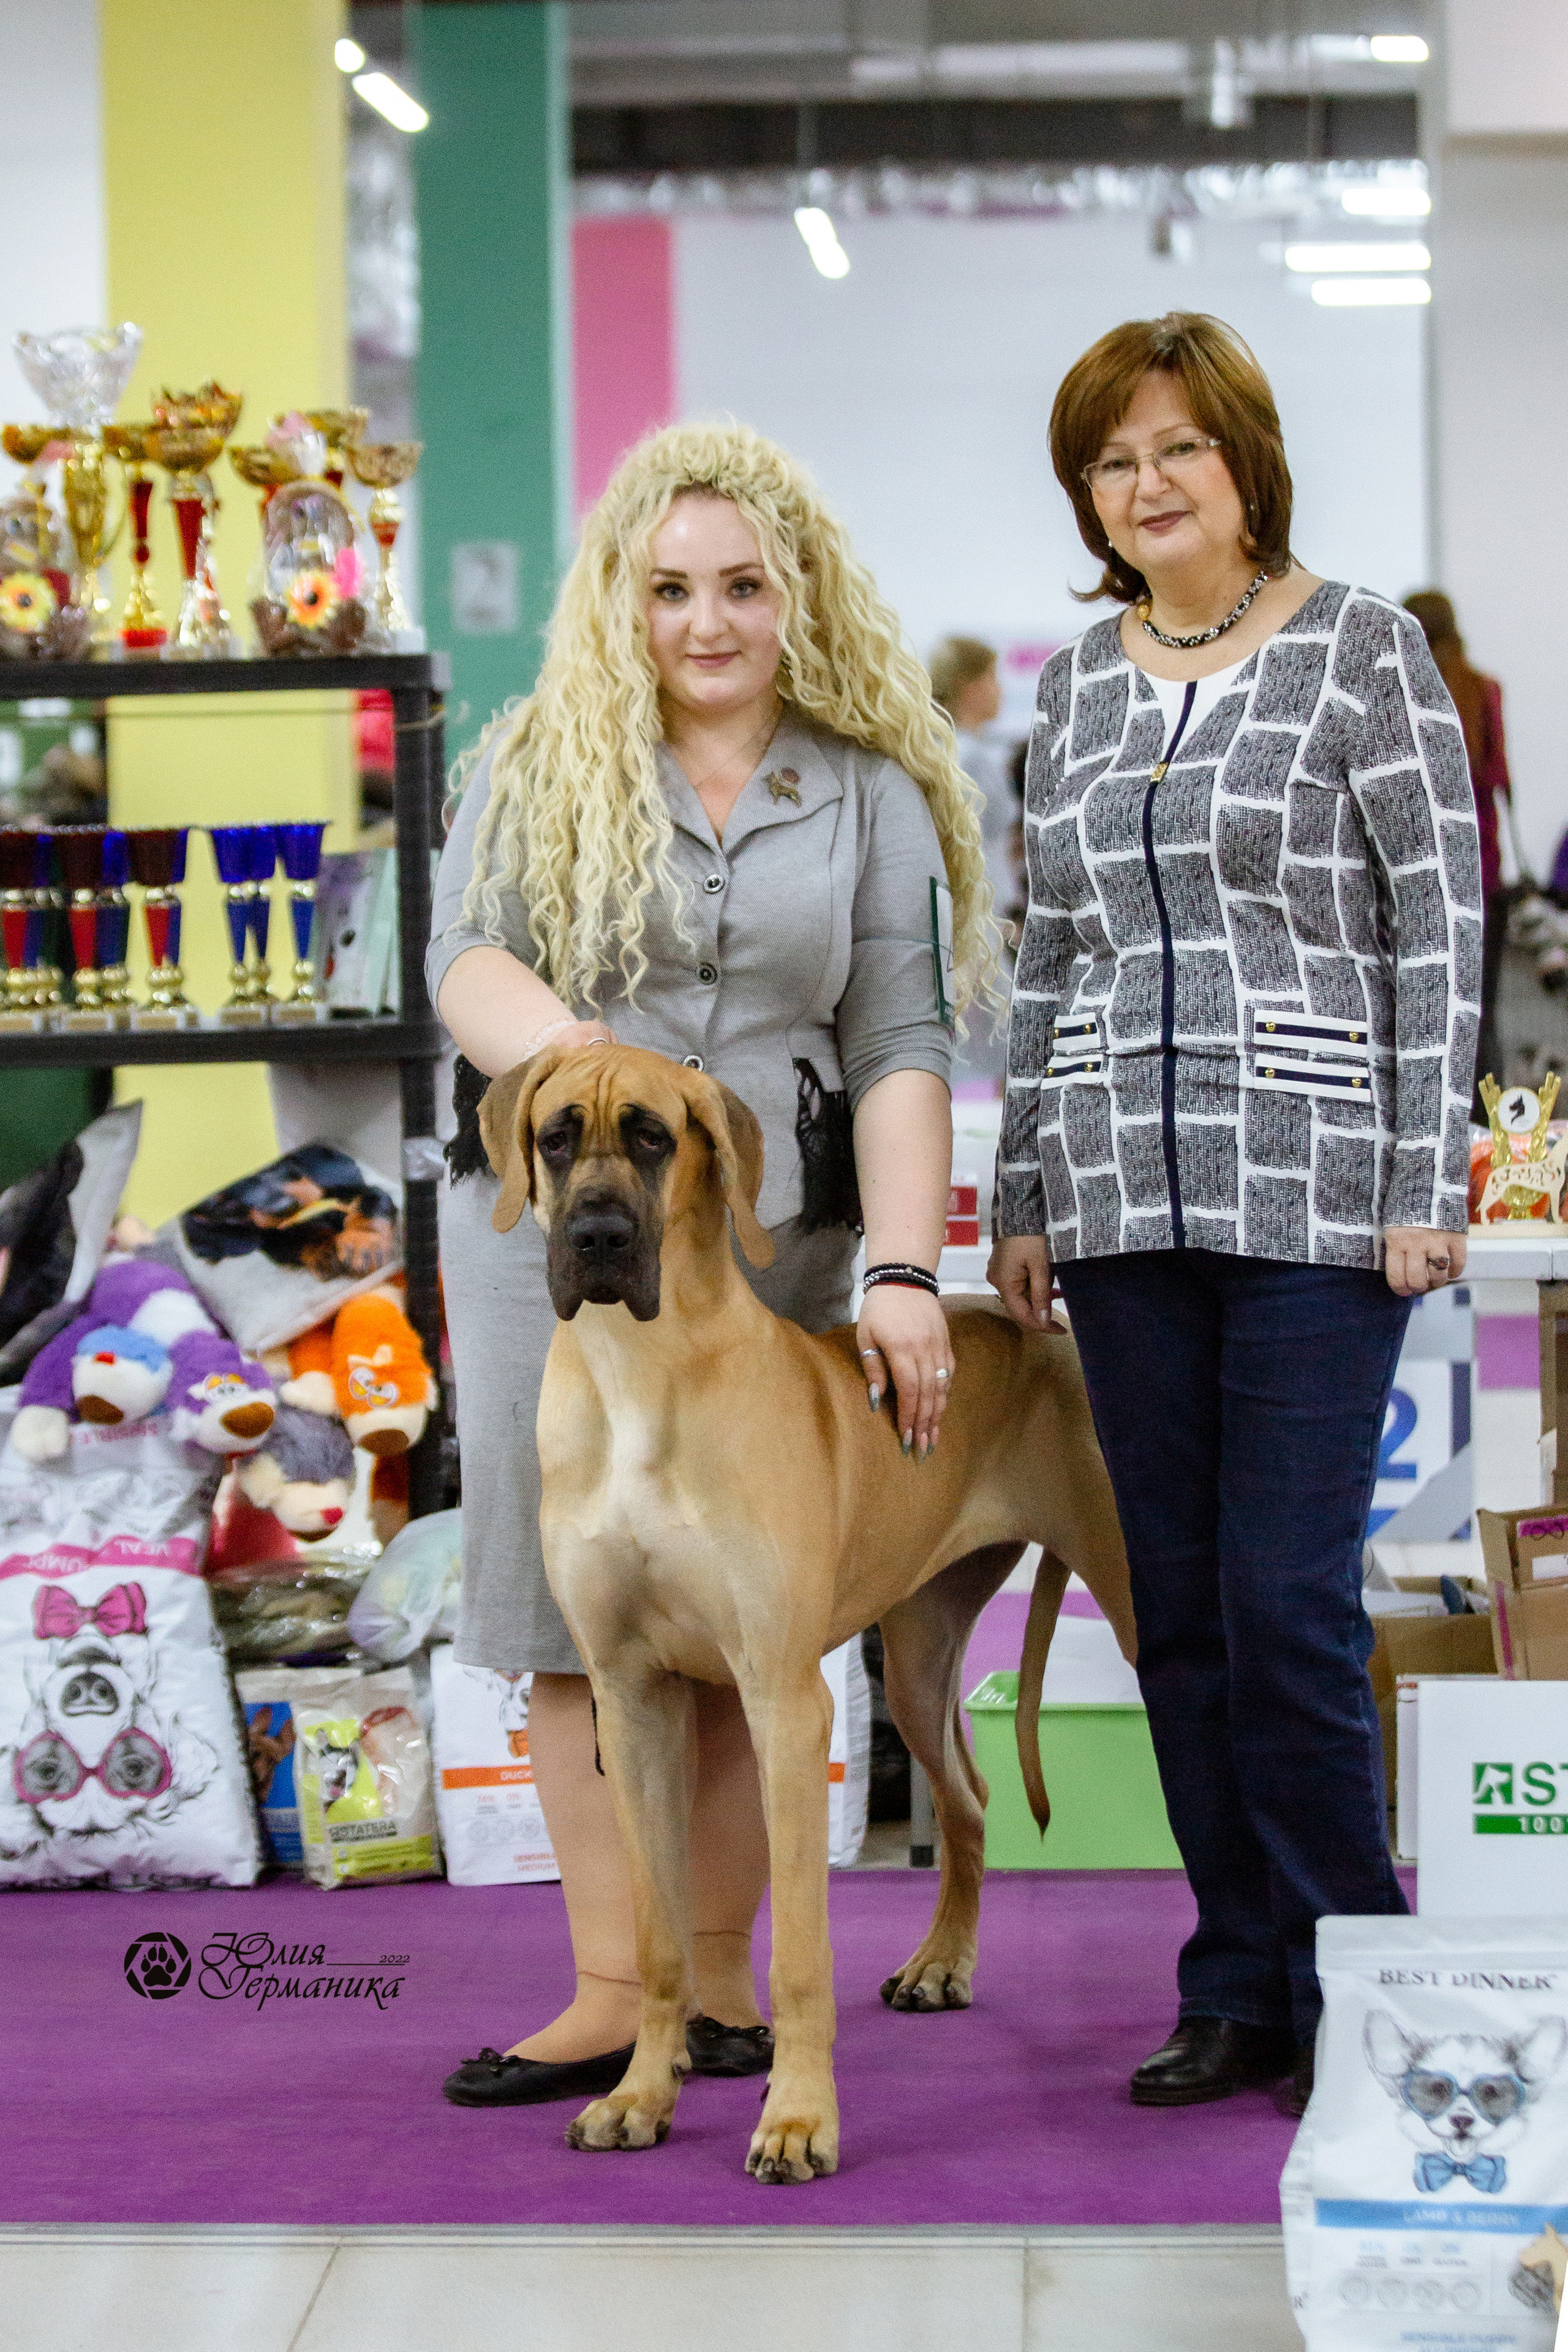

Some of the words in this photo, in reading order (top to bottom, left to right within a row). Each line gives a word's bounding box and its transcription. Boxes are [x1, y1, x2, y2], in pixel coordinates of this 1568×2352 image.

[1522, 1762, 1568, 1806] S
[1518, 1816, 1568, 1834] 100
[1379, 1969, 1441, 1986] BEST
[1451, 1971, 1552, 1990] DINNER
